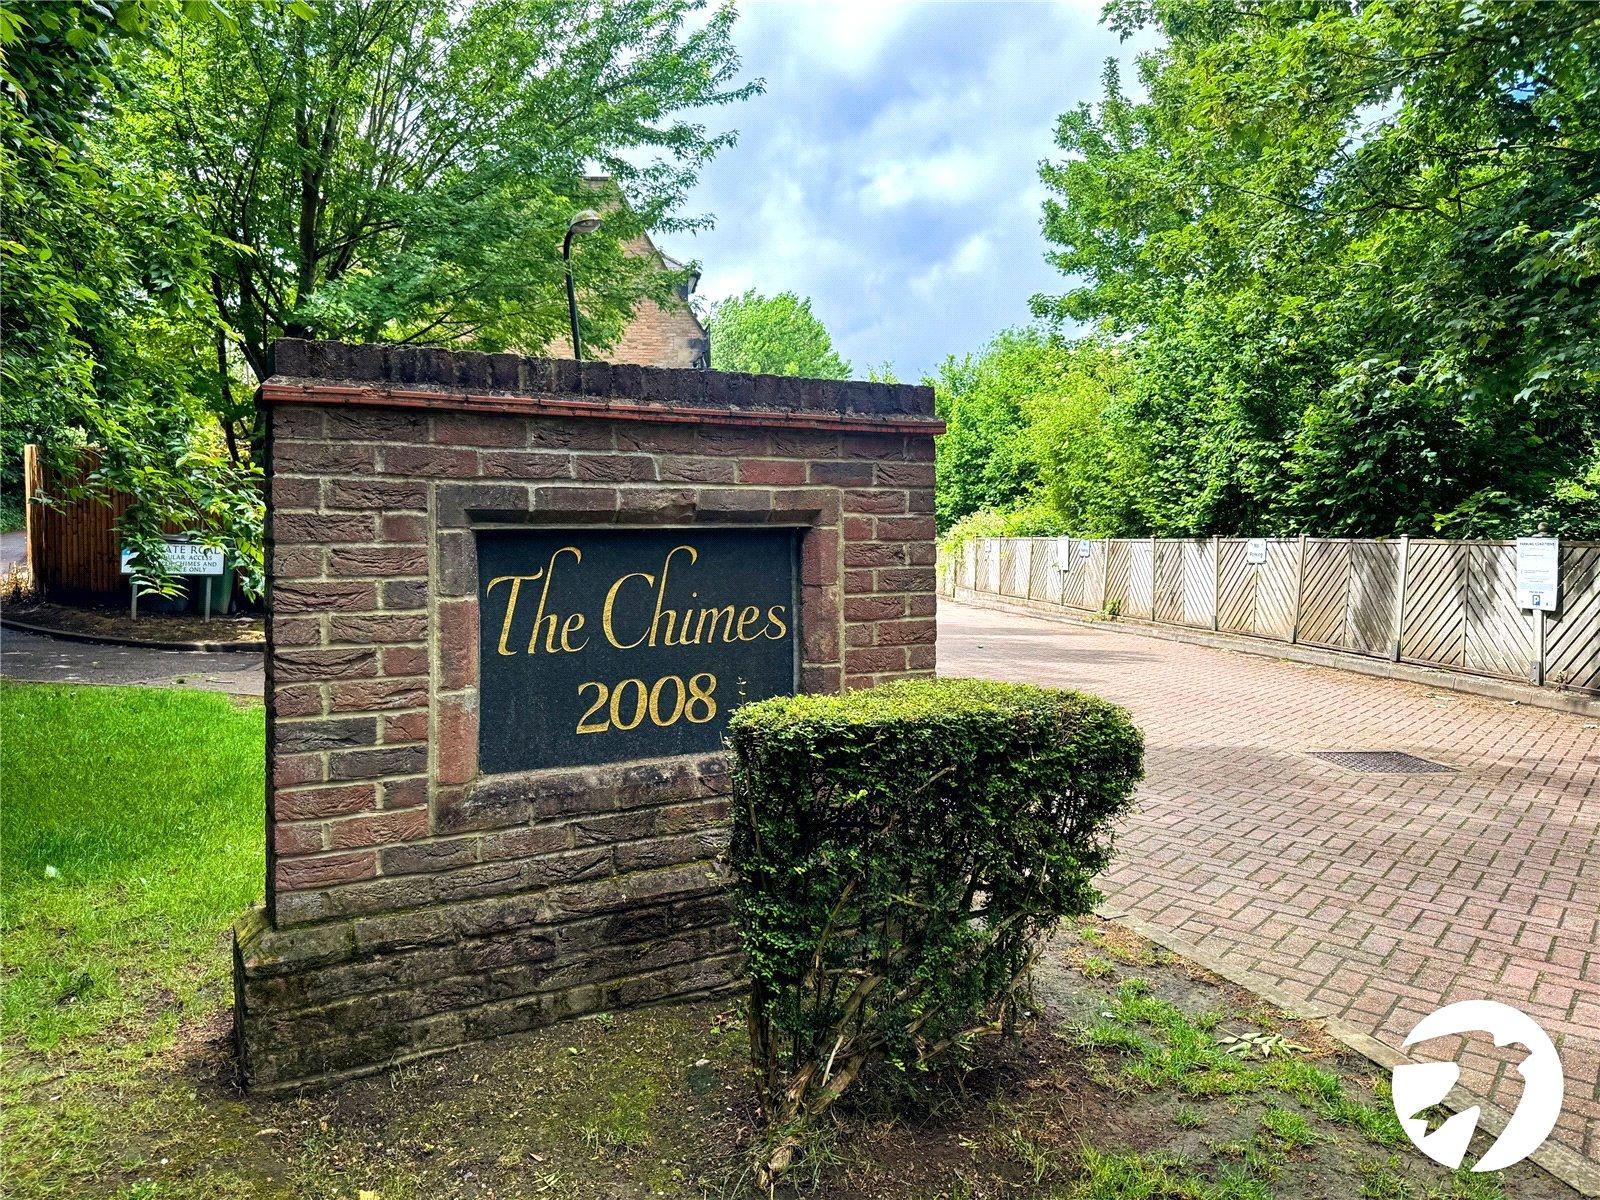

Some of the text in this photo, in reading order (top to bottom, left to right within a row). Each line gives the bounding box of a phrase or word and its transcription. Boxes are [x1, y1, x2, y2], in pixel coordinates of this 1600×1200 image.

[486, 545, 787, 656] The Chimes
[576, 672, 718, 735] 2008
